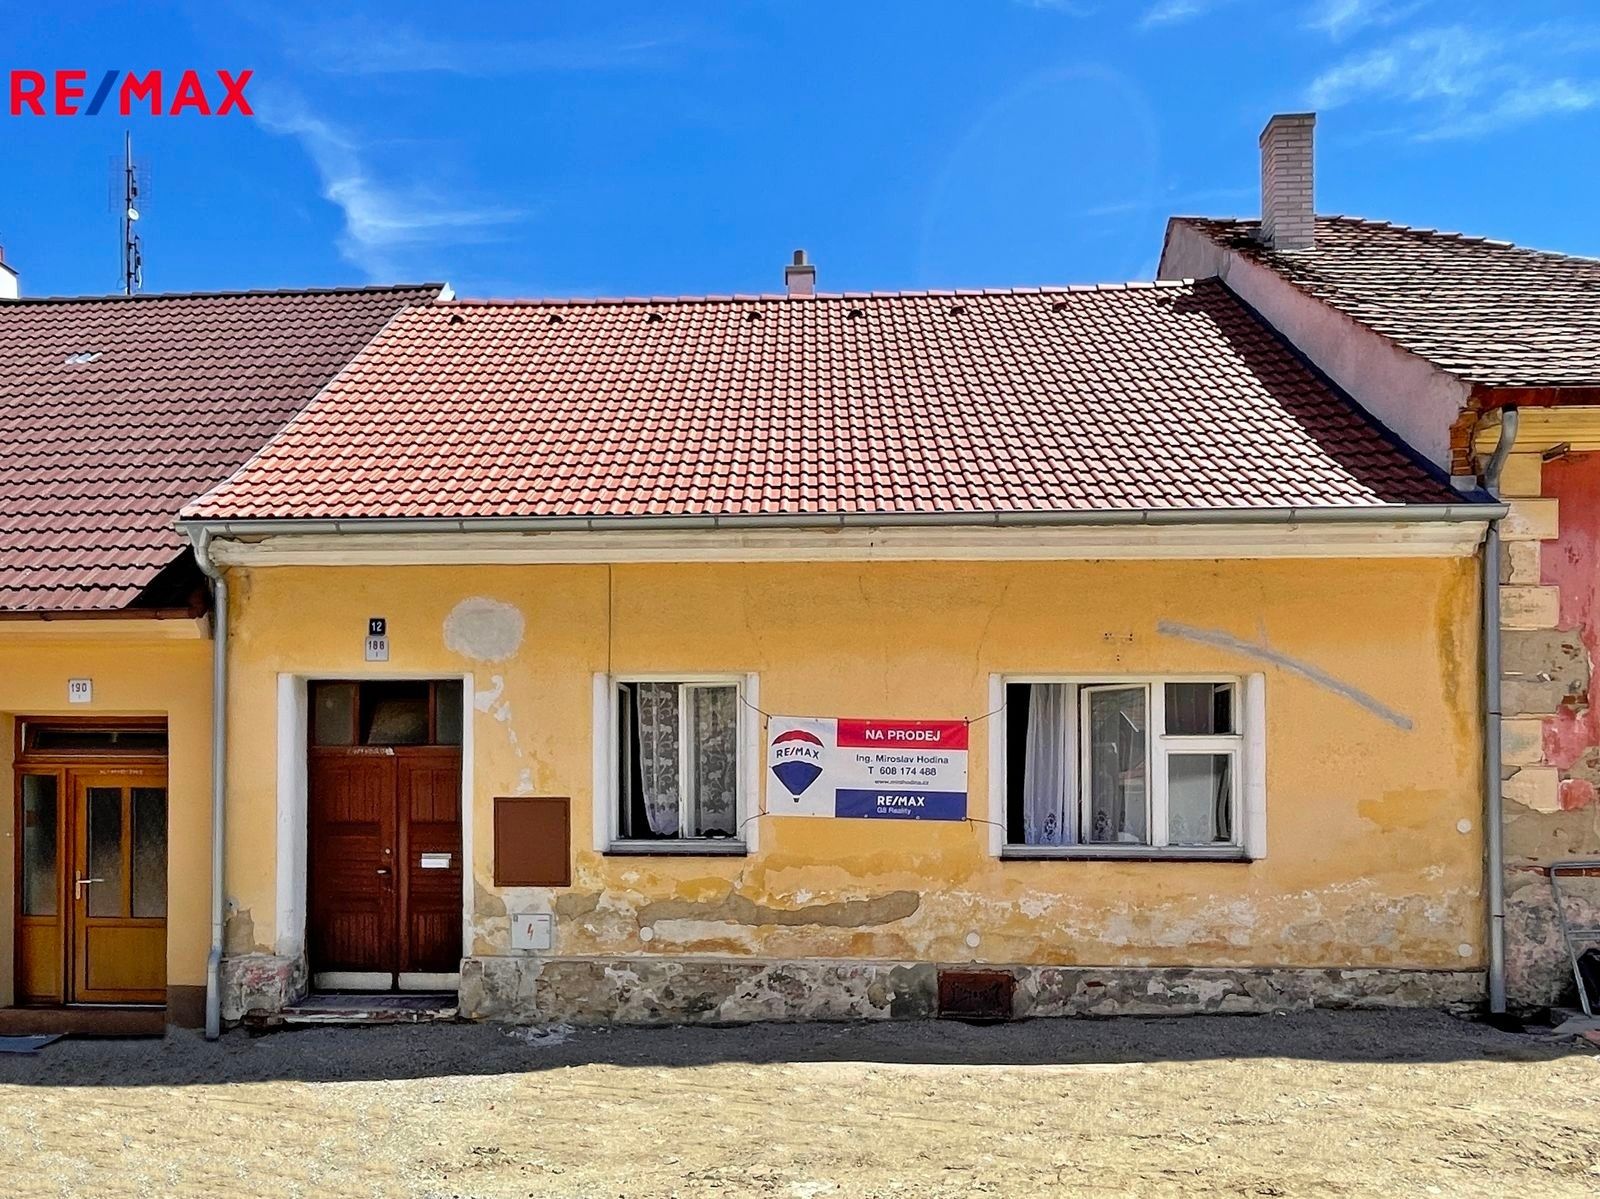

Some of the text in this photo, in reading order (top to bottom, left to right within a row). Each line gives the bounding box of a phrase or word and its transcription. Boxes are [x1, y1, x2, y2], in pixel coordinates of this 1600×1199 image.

[371, 621, 383, 632] 12
[71, 683, 87, 692] 190
[865, 729, 941, 741] NA PRODEJ
[776, 747, 820, 759] RE/MAX
[856, 754, 949, 764] Ing. Miroslav Hodina
[868, 766, 937, 776] T 608 174 488
[877, 795, 925, 807] RE/MAX
